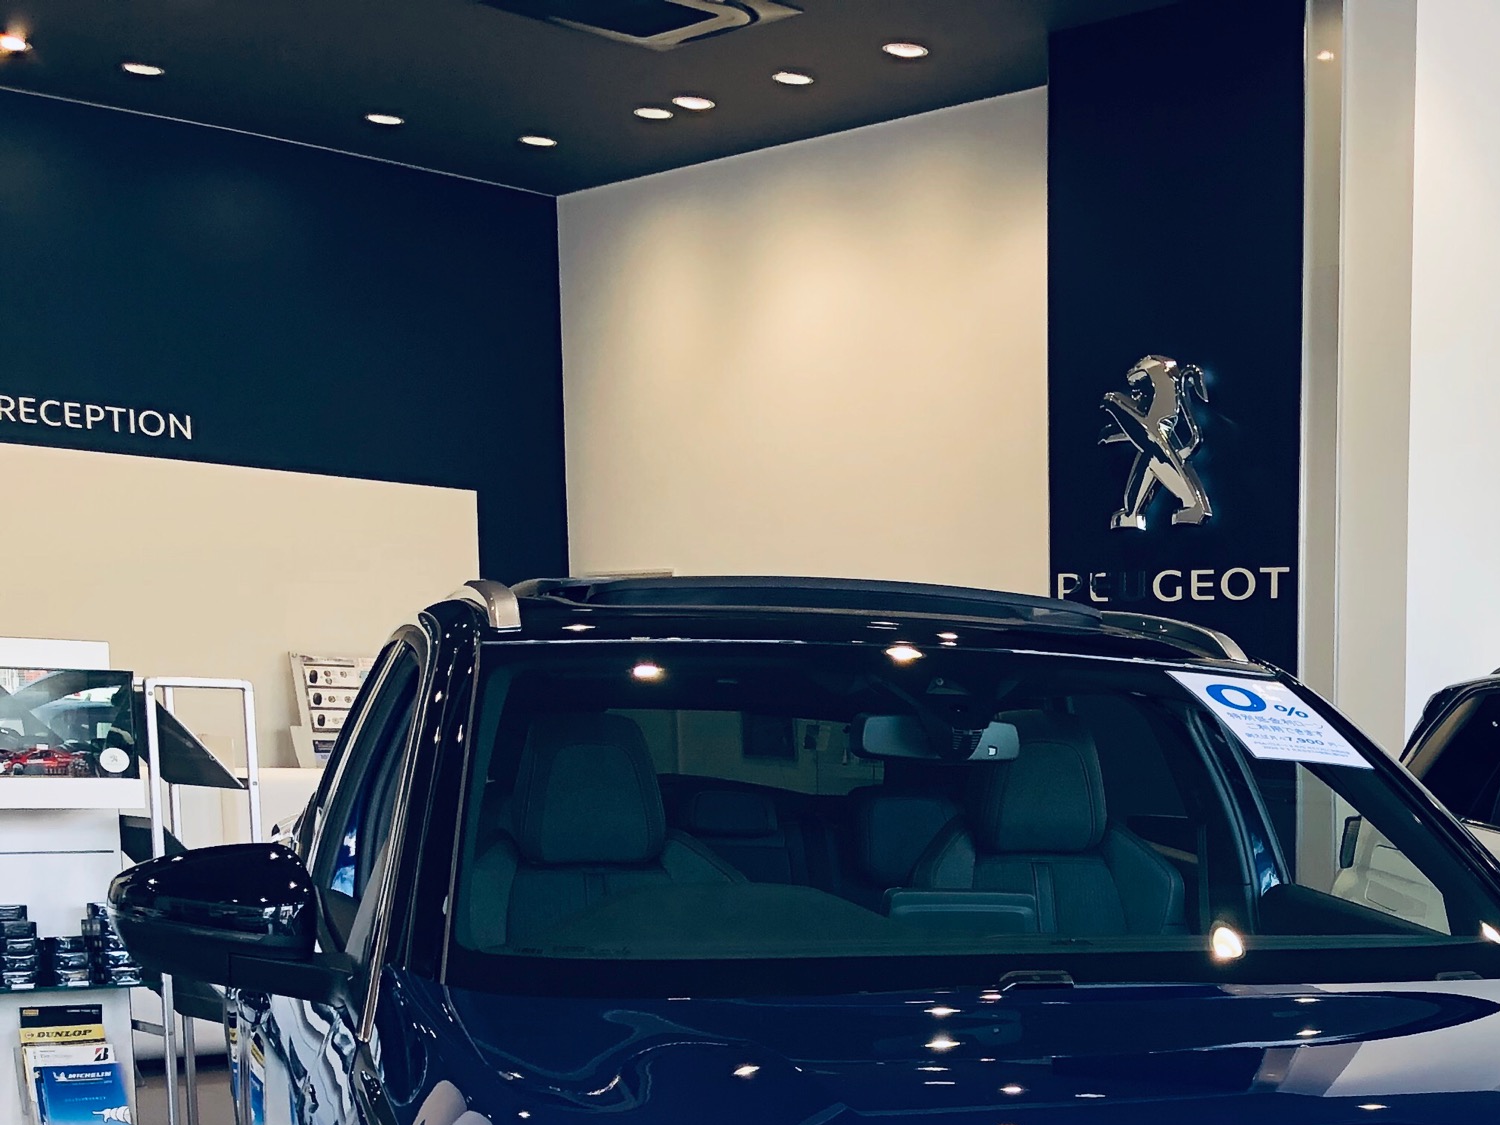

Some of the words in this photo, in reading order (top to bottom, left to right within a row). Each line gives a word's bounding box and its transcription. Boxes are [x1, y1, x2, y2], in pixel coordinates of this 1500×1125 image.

[0, 395, 192, 440] RECEPTION
[36, 1029, 93, 1039] DUNLOP
[67, 1071, 112, 1079] MICHELIN
